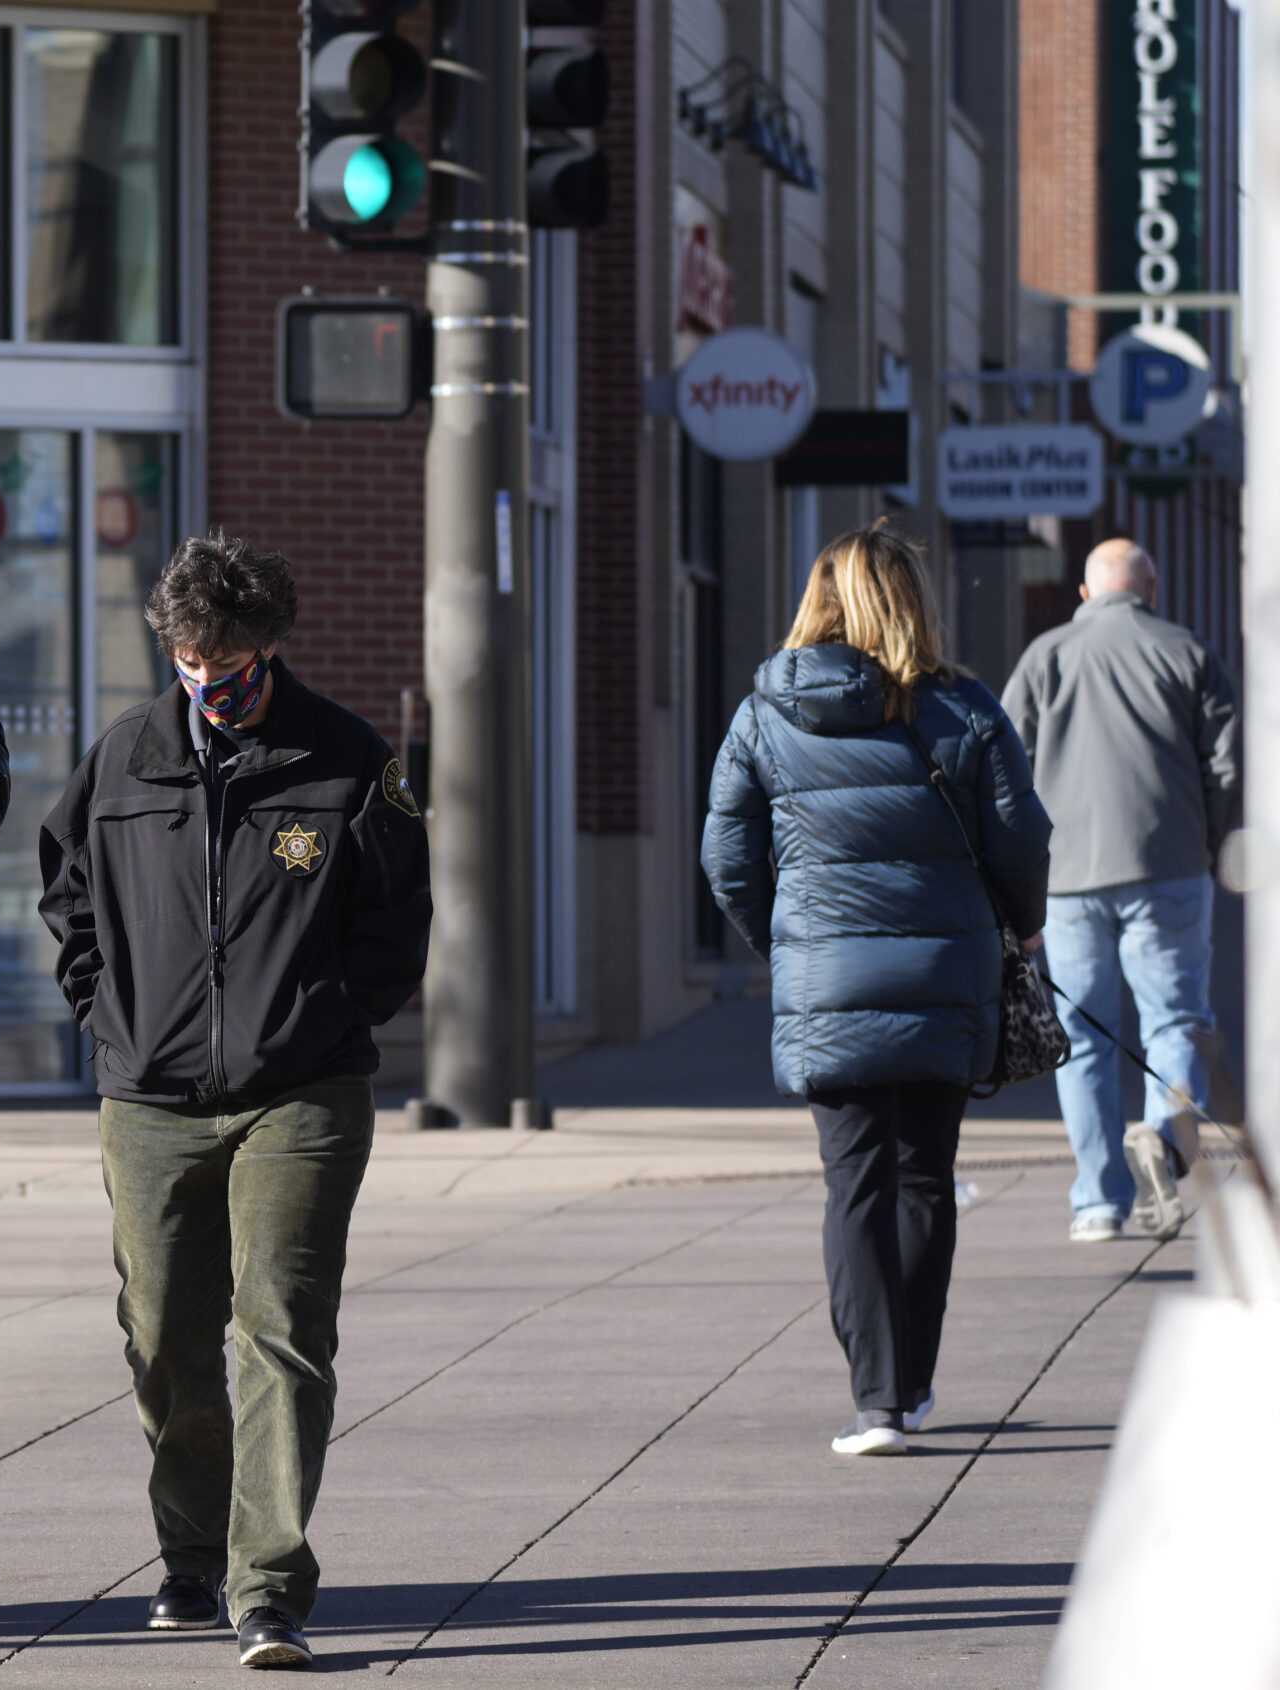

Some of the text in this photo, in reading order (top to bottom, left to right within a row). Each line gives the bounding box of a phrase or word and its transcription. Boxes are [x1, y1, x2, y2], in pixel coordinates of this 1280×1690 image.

[688, 372, 802, 416] xfinity
[1122, 350, 1189, 424] P
[1020, 479, 1087, 498] CENTER
